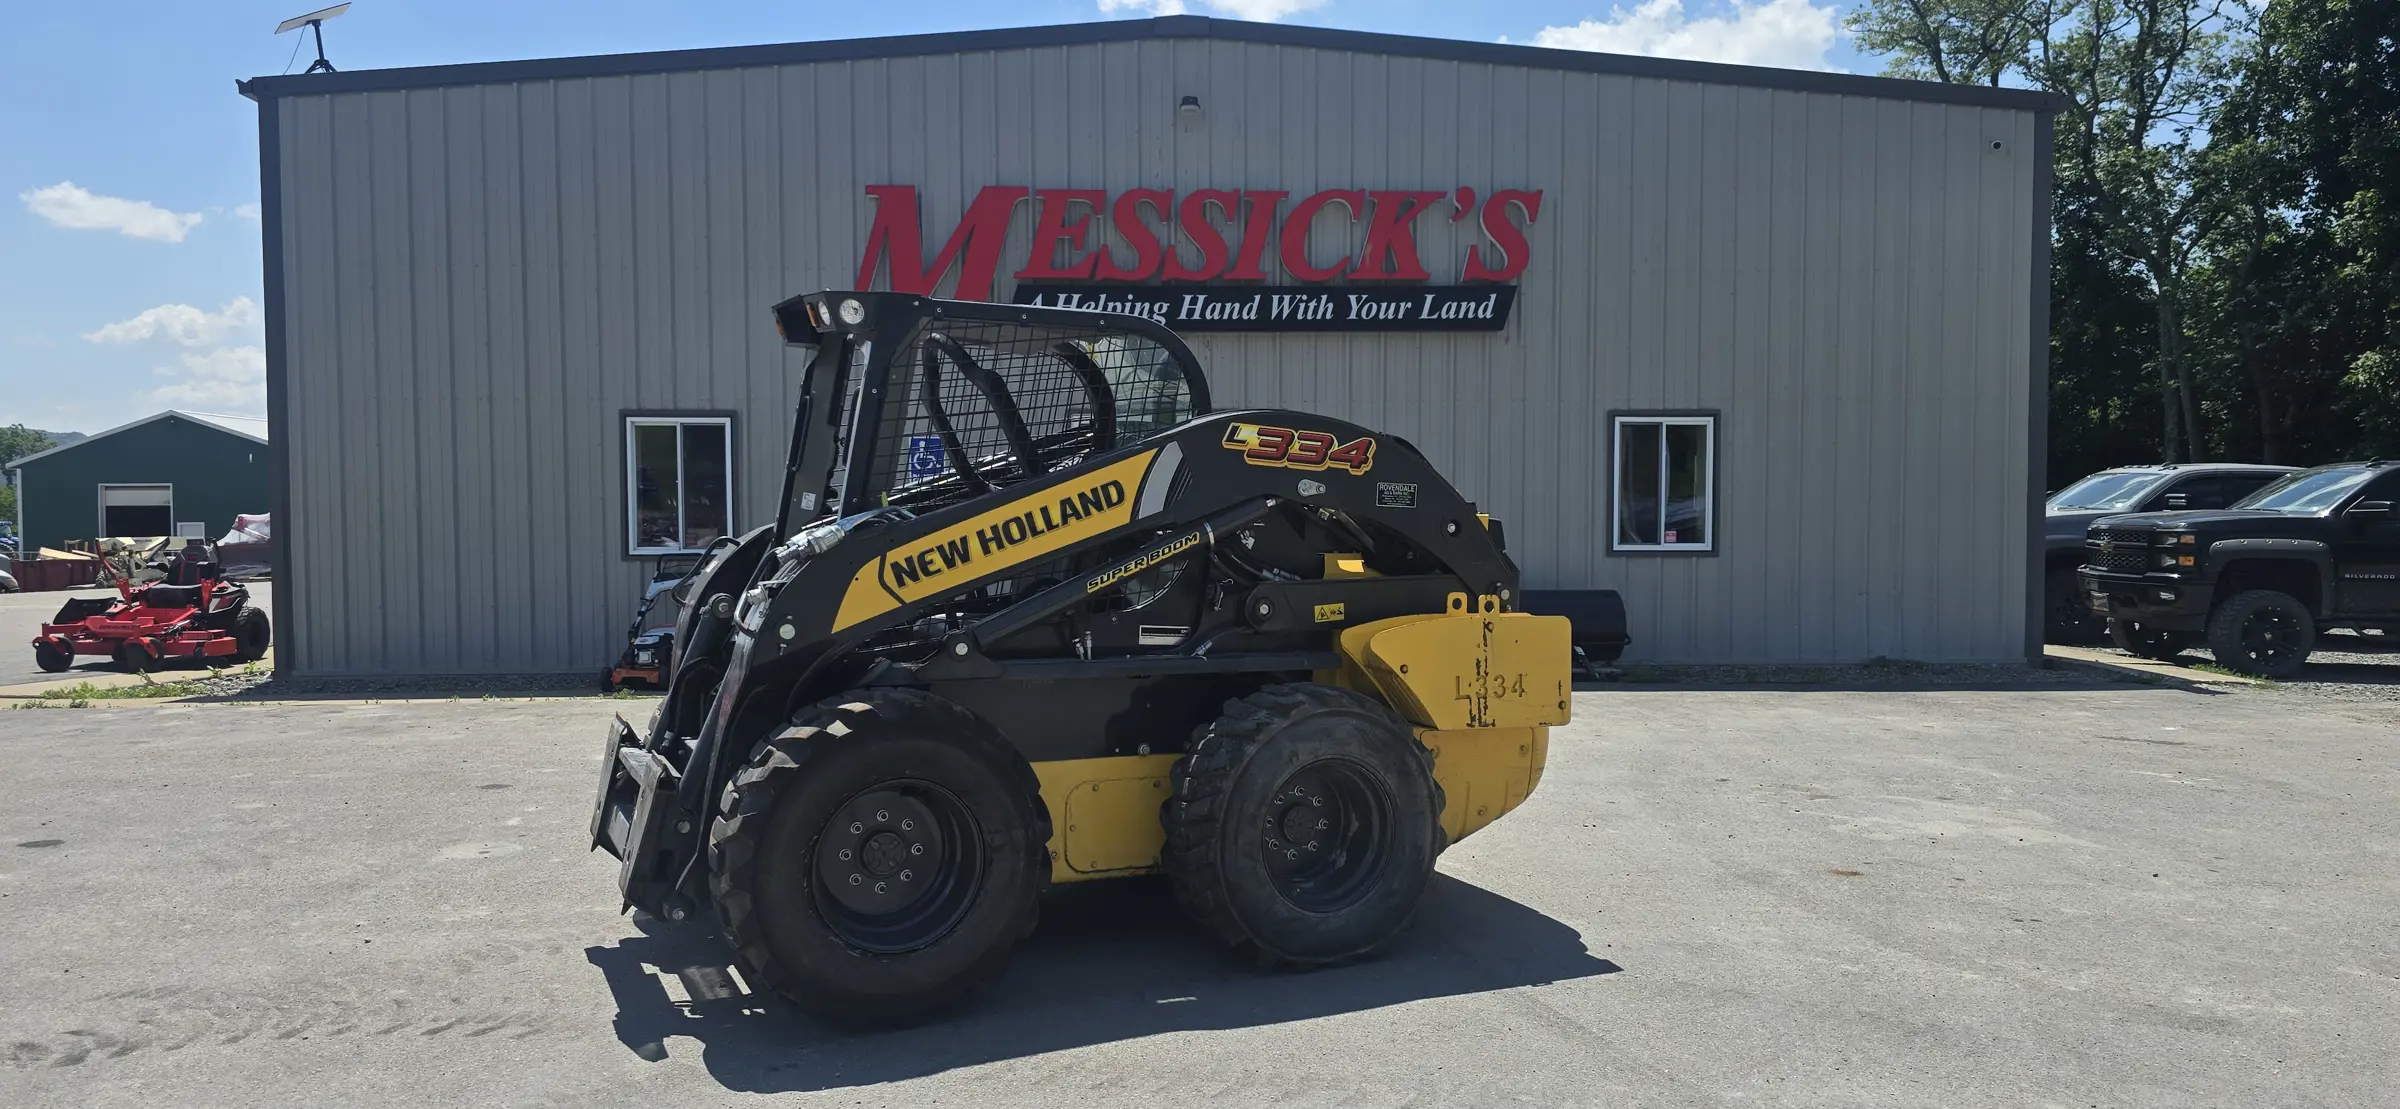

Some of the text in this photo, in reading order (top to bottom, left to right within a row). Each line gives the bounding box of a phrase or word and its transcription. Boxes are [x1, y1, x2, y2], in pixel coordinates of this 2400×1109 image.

[855, 184, 1543, 302] MESSICK'S
[1177, 294, 1260, 320] Hand
[1271, 294, 1333, 320] With
[1347, 294, 1411, 320] Your
[1419, 293, 1496, 320] Land
[1223, 423, 1374, 472] L334
[890, 479, 1126, 588] NEW HOLLAND
[1087, 532, 1199, 593] SUPER BOOM
[1454, 673, 1525, 701] L334
